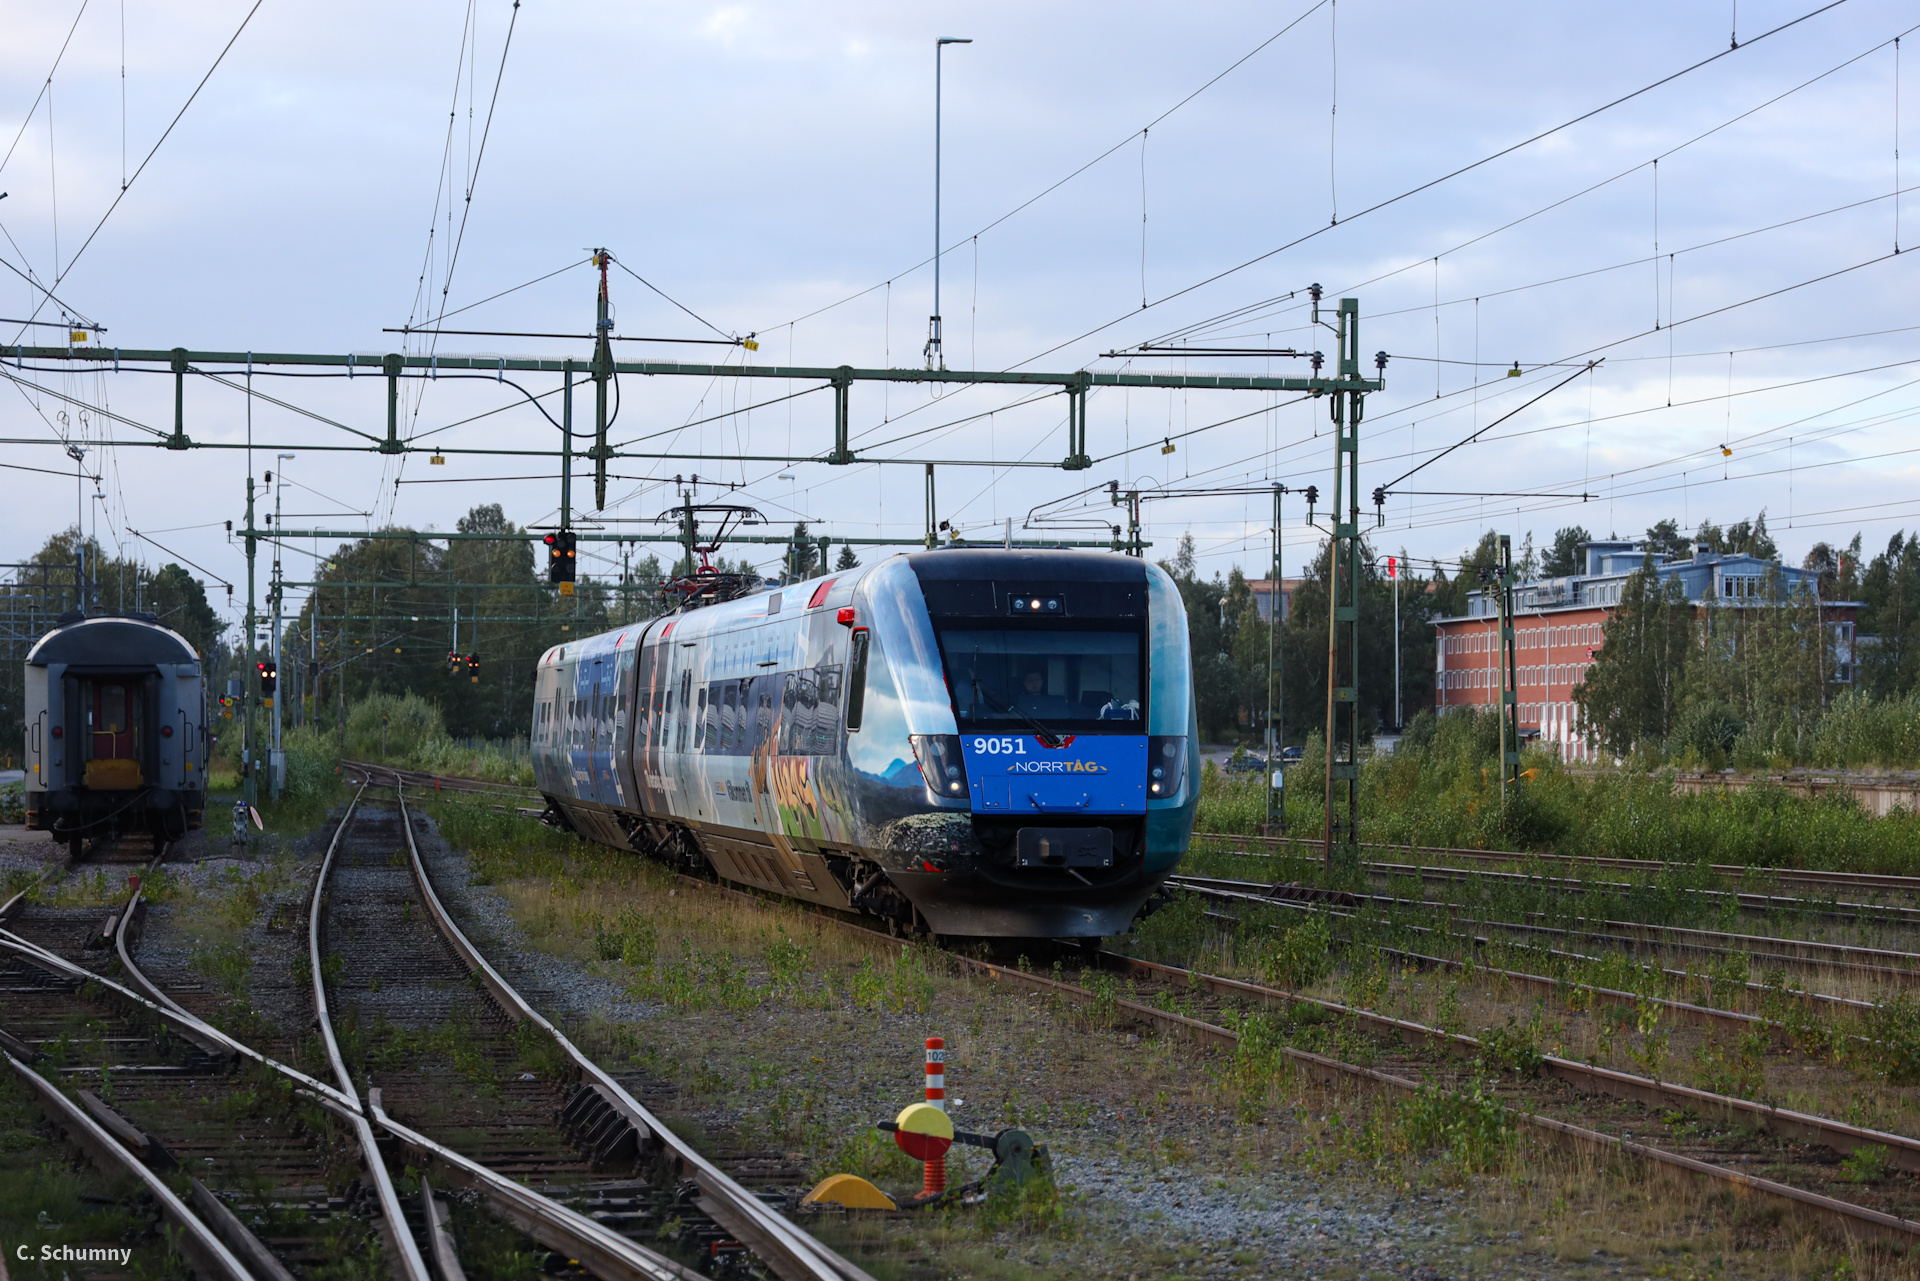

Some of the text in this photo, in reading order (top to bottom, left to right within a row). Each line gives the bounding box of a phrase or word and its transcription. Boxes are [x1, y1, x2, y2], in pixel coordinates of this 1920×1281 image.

[745, 341, 757, 350] A14
[973, 737, 1027, 755] 9051
[1015, 759, 1099, 773] NORRTÅG
[927, 1051, 944, 1062] 102
